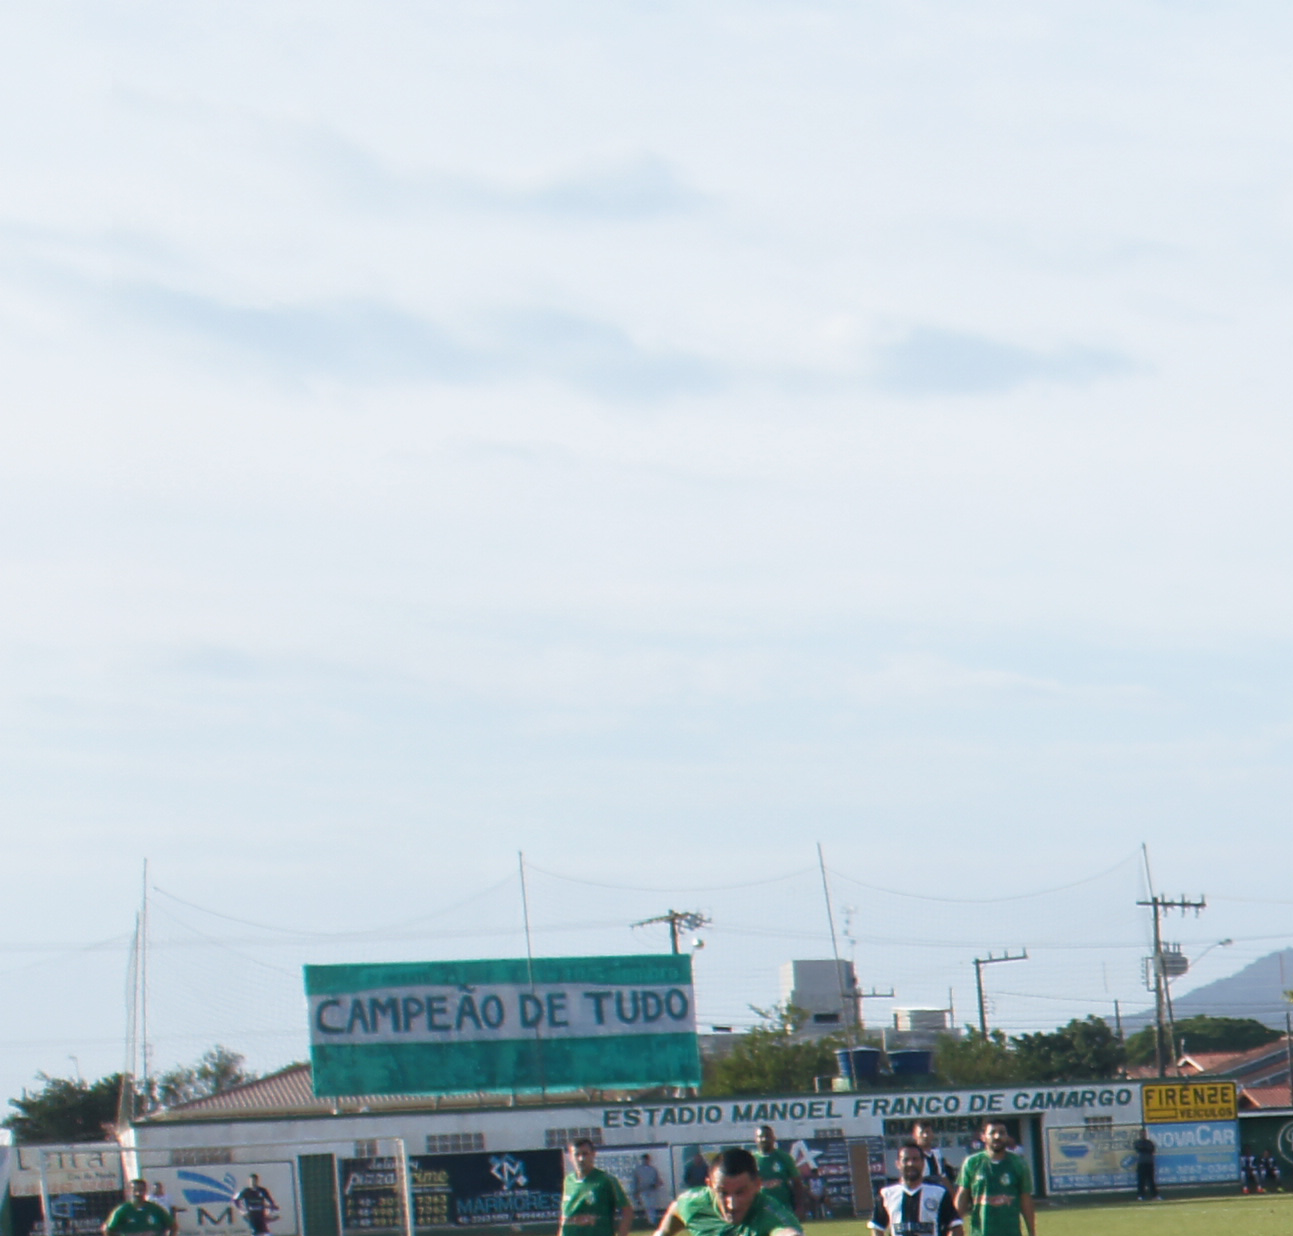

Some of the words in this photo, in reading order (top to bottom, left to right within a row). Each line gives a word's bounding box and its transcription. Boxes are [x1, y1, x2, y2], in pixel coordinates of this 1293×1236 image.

[315, 984, 505, 1034] CAMPEÃO
[520, 992, 569, 1028] DE
[583, 988, 689, 1025] TUDO
[603, 1105, 722, 1128] ESTADIO
[732, 1100, 842, 1122] MANOEL
[854, 1095, 961, 1117] FRANCO
[969, 1093, 1005, 1113] DE
[1013, 1089, 1132, 1110] CAMARGO
[456, 1193, 562, 1214] MARMORES
